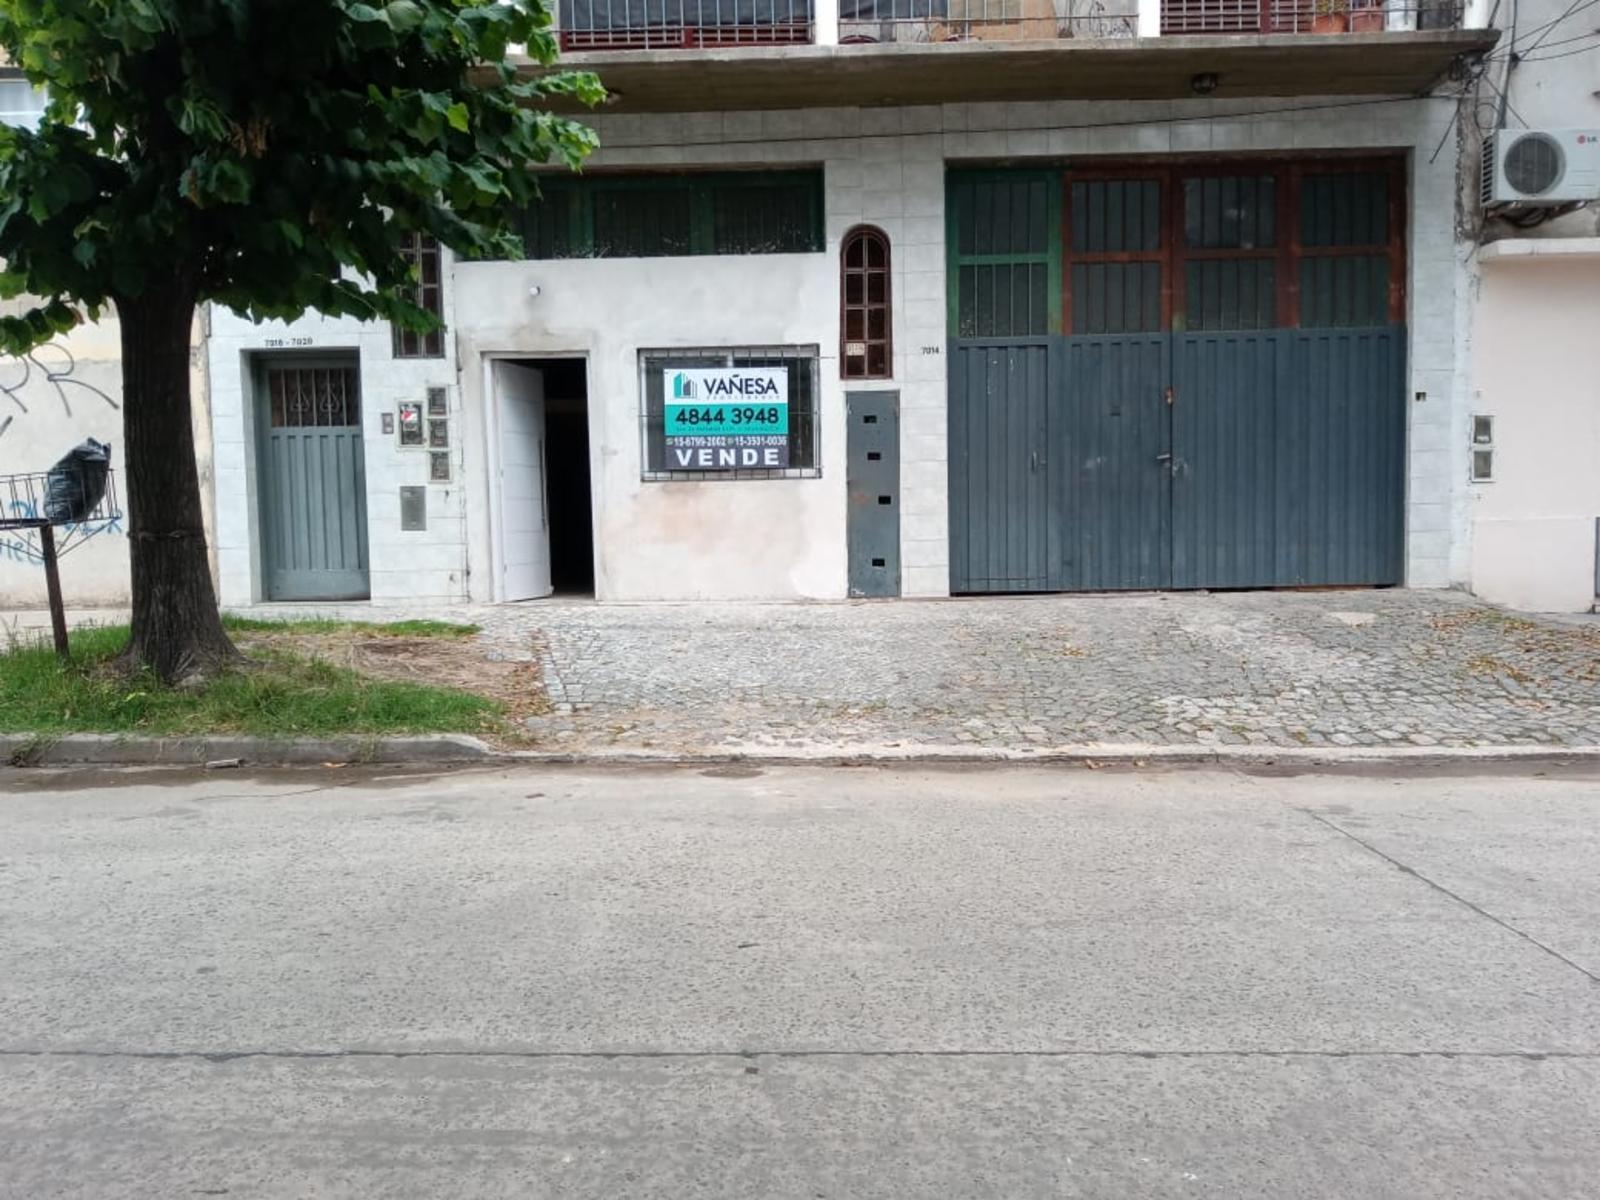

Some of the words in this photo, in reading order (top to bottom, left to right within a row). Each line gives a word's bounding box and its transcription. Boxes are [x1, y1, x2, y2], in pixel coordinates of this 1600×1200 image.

[921, 346, 940, 355] 7014
[703, 374, 778, 395] VAÑESA
[675, 407, 726, 425] 4844
[731, 407, 779, 425] 3948
[675, 448, 780, 467] VENDE
